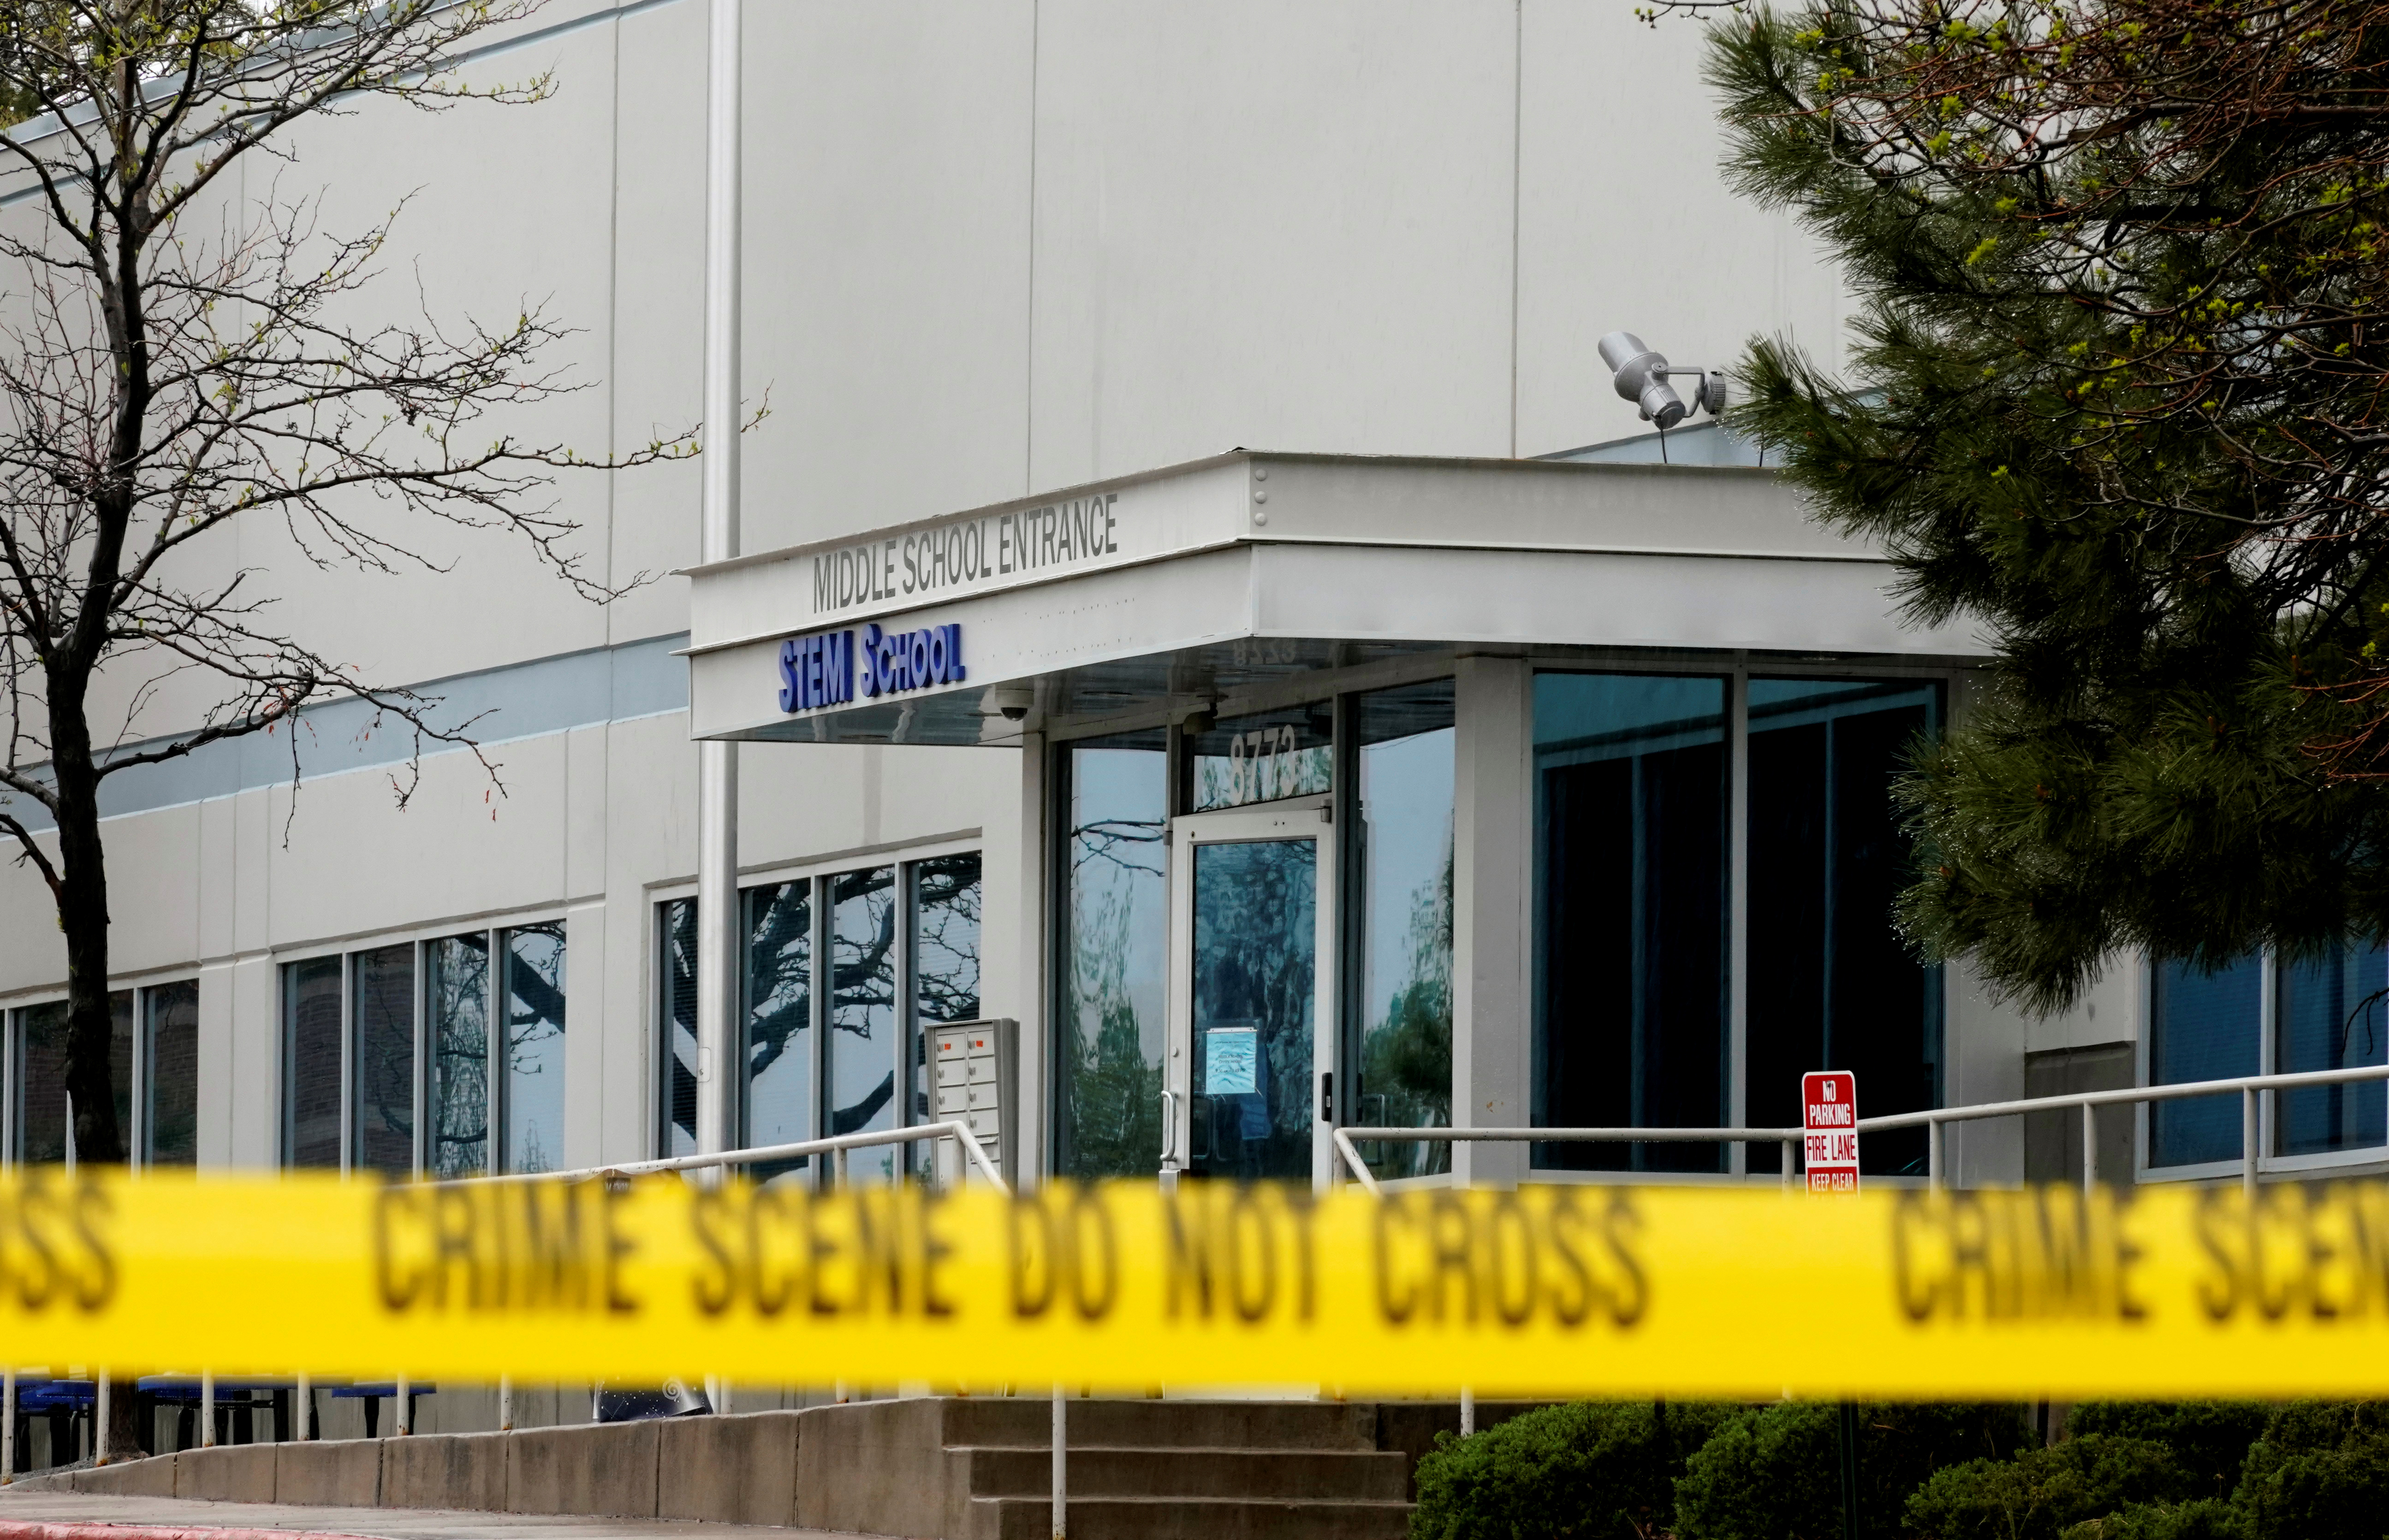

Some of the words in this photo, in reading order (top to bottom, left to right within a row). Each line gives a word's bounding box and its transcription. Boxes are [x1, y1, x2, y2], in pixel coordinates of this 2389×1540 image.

[813, 540, 897, 614] MIDDLE
[903, 518, 992, 595] SCHOOL
[999, 493, 1118, 575] ENTRANCE
[778, 629, 853, 713] STEM
[1230, 723, 1296, 806] 8773
[1809, 1103, 1851, 1126] PARKING
[1822, 1080, 1836, 1102] NO
[1806, 1135, 1827, 1161] FIRE
[1831, 1134, 1856, 1161] LANE
[1811, 1173, 1830, 1192] KEEP
[1832, 1173, 1854, 1191] CLEAR
[374, 1180, 642, 1318] CRIME
[690, 1183, 957, 1320] SCENE
[1006, 1186, 1118, 1323] DO
[1159, 1186, 1322, 1326] NOT
[1373, 1188, 1652, 1329] CROSS
[1889, 1186, 2153, 1326] CRIME
